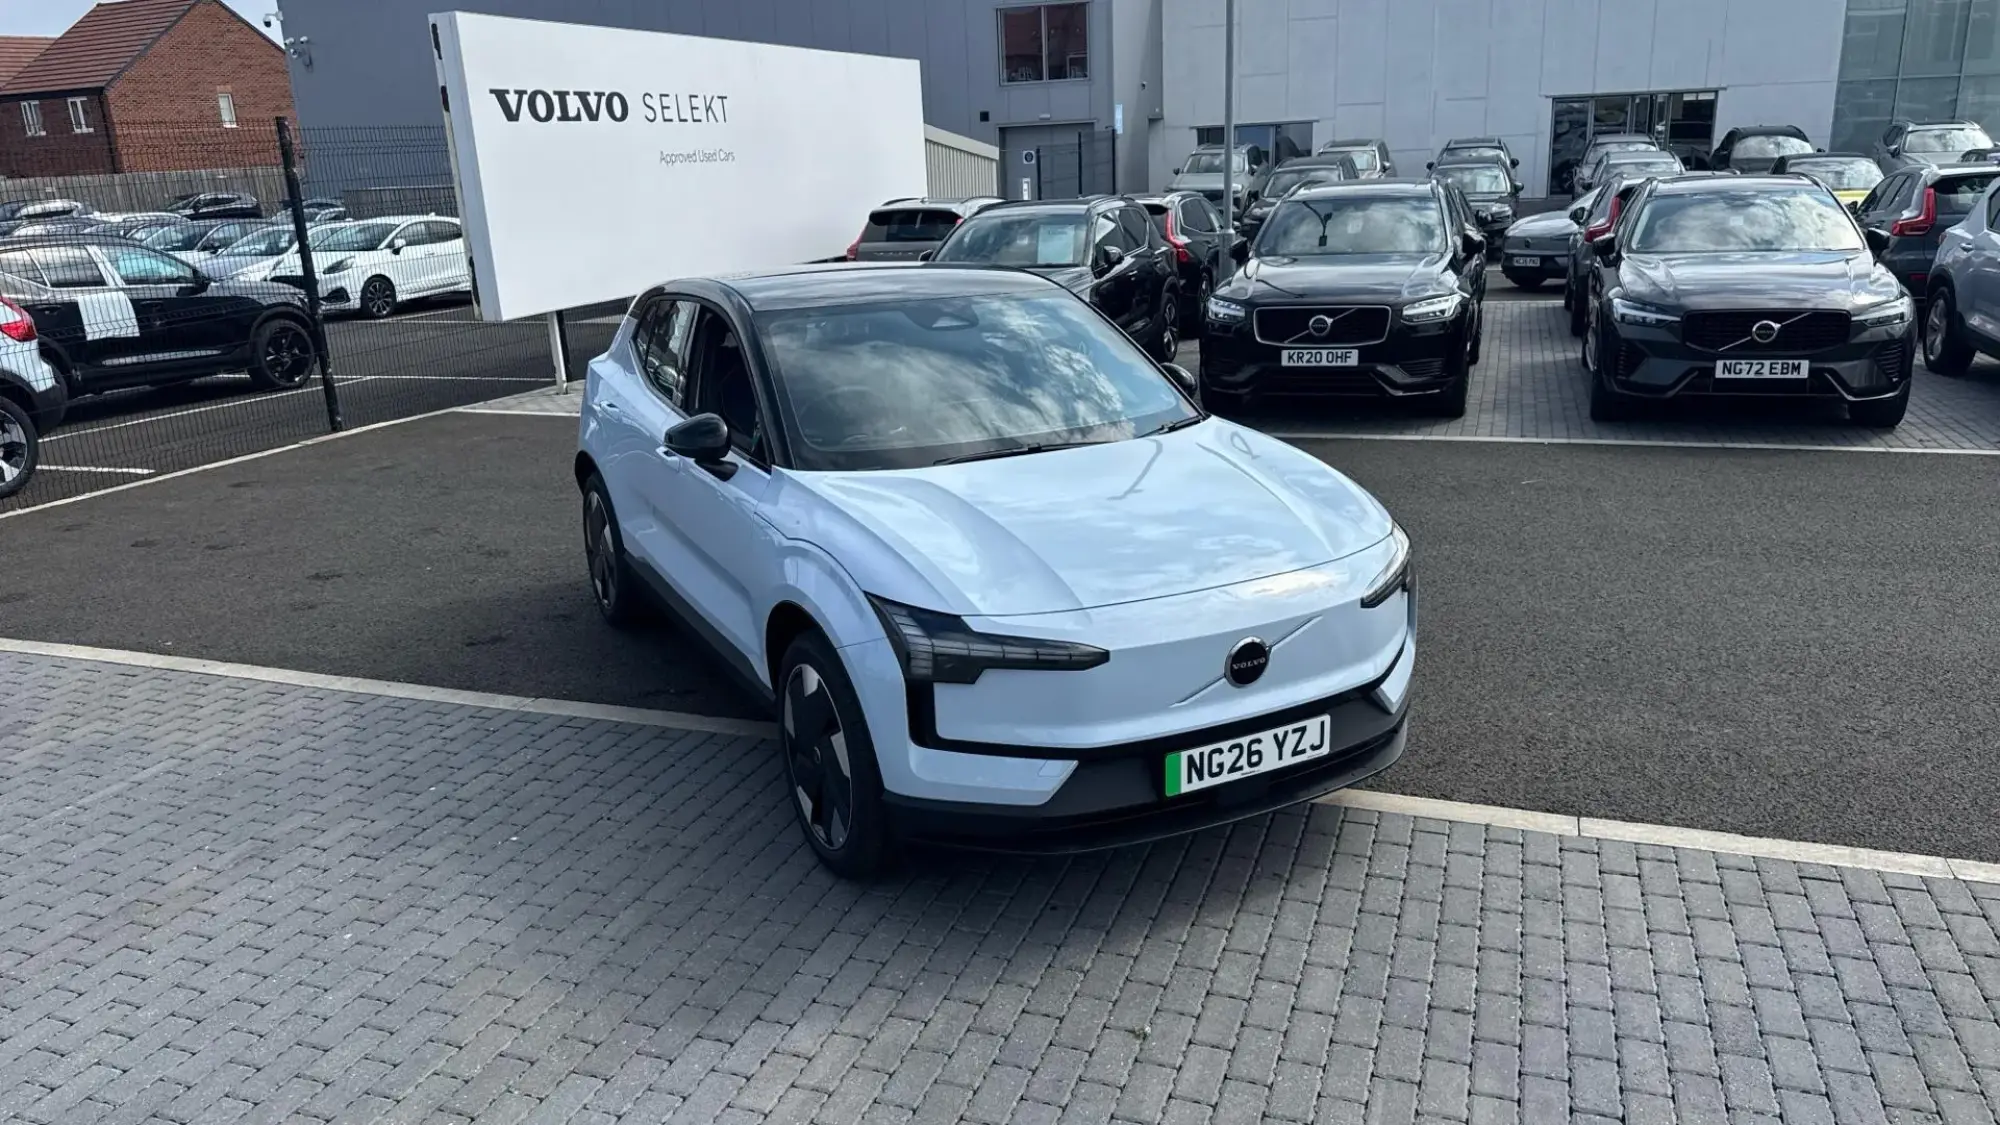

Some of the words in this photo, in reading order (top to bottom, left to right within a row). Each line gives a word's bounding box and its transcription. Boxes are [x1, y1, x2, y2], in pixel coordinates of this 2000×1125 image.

[489, 88, 629, 123] VOLVO
[642, 92, 728, 123] SELEKT
[660, 150, 697, 166] Approved
[698, 149, 717, 162] Used
[718, 148, 735, 162] Cars
[1287, 351, 1323, 364] KR20
[1326, 351, 1352, 364] OHF
[1722, 361, 1765, 375] NG72
[1769, 361, 1801, 375] EBM
[1232, 657, 1266, 670] VOLVO
[1187, 737, 1263, 784] NG26
[1273, 720, 1325, 761] YZJ
